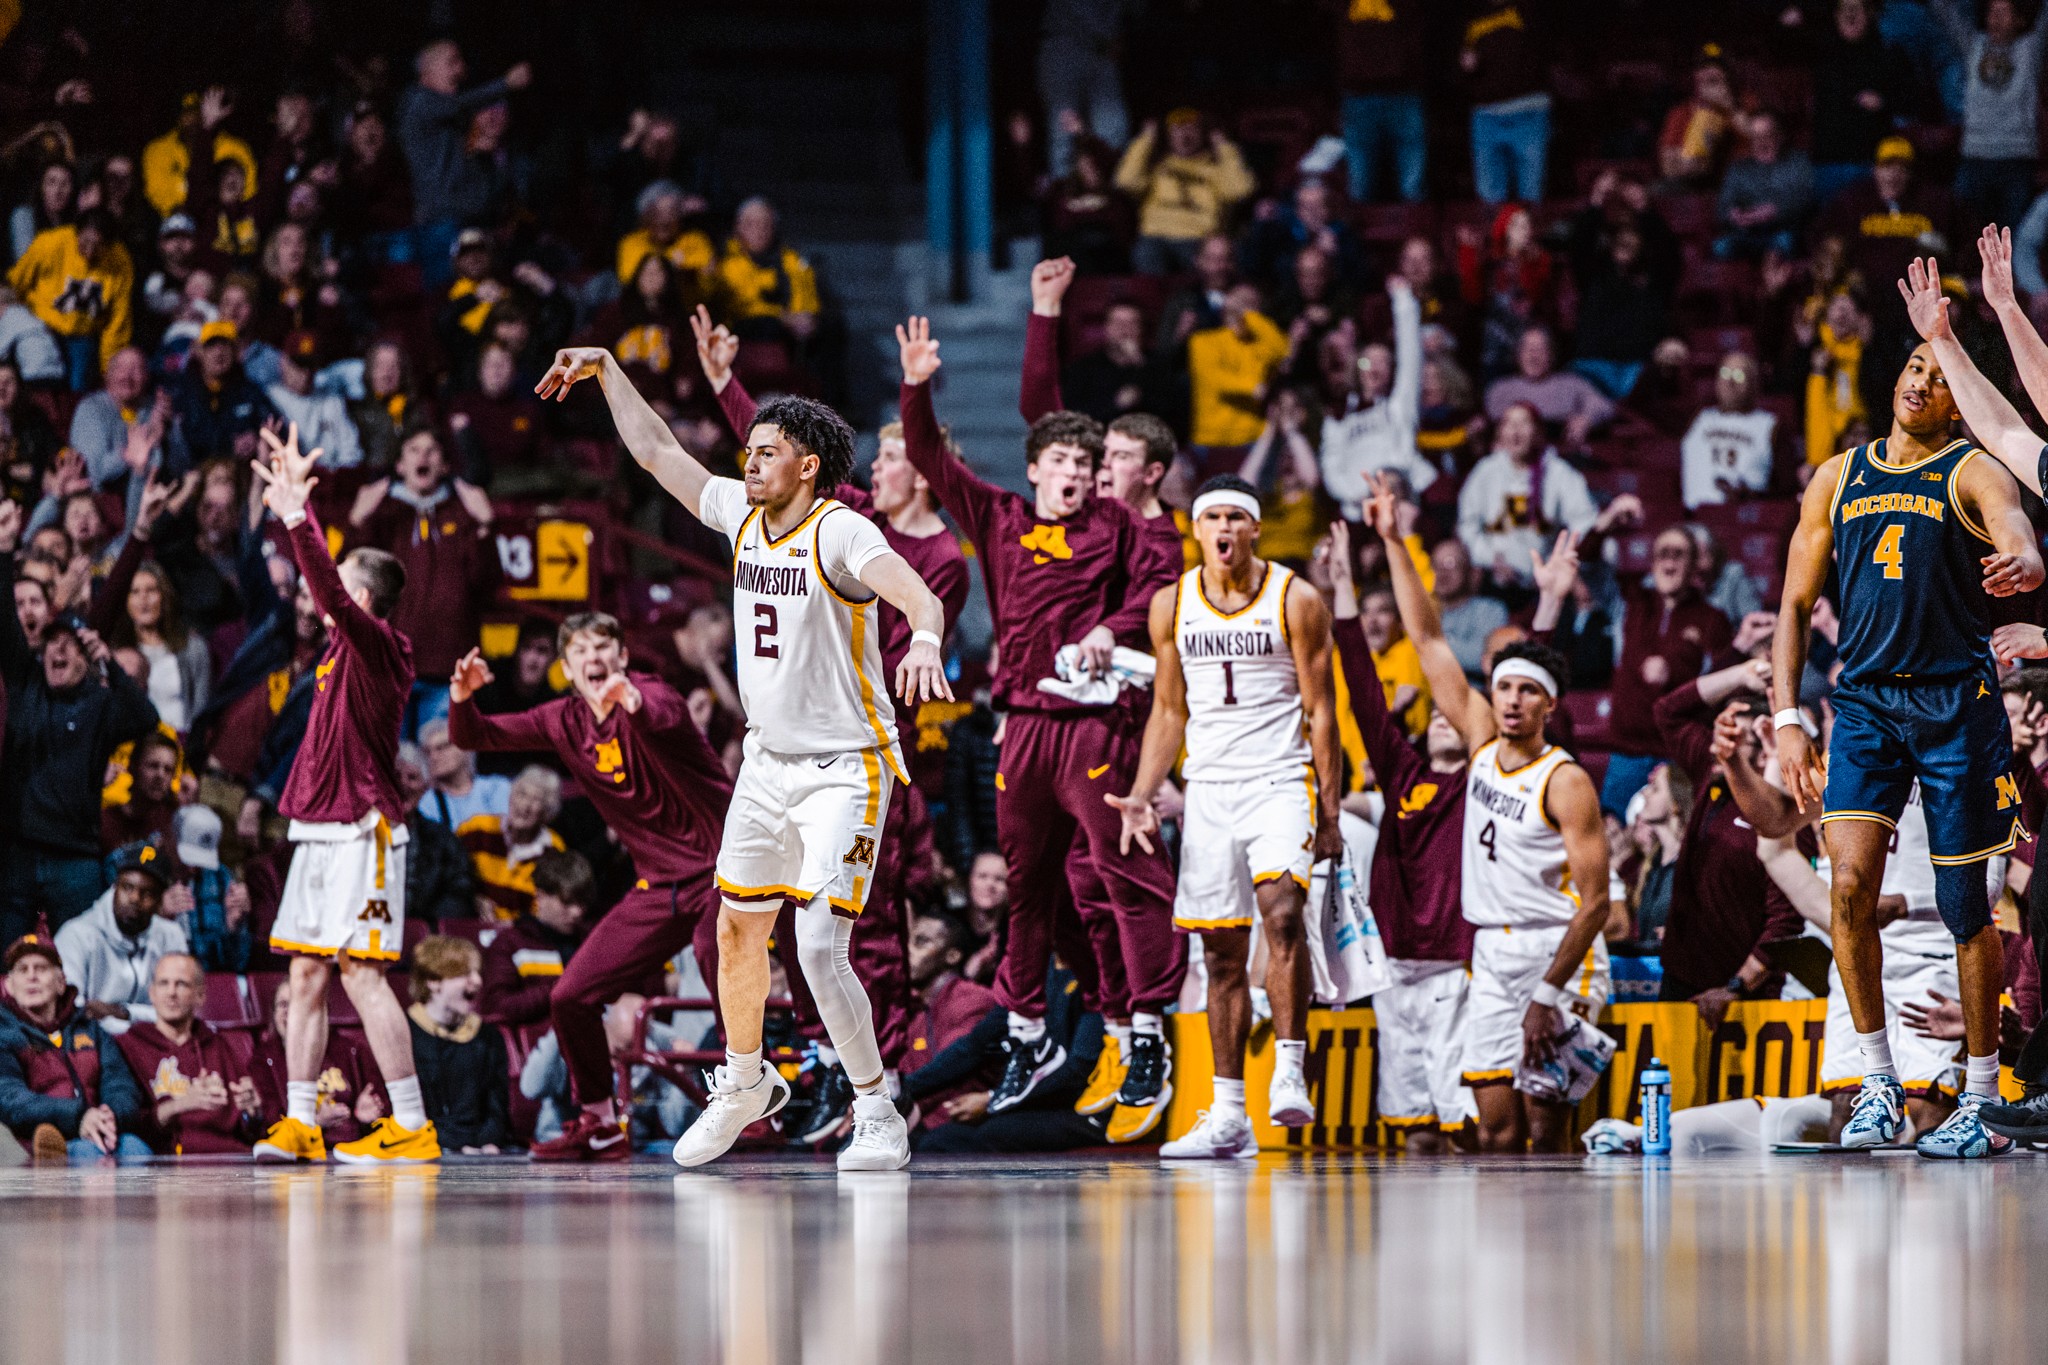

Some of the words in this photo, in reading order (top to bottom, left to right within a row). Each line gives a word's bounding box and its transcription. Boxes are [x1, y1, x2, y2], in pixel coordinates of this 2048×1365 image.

[1842, 492, 1945, 525] MICHIGAN
[1873, 524, 1905, 580] 4
[735, 560, 808, 597] MINNESOTA
[754, 602, 779, 659] 2
[1185, 631, 1273, 657] MINNESOTA
[1222, 660, 1238, 705] 1
[1471, 777, 1526, 823] MINNESOTA
[1994, 772, 2022, 811] M
[842, 834, 876, 870] M
[1479, 819, 1497, 862] 4
[357, 898, 393, 925] M
[1647, 1085, 1659, 1143] POWERADE
